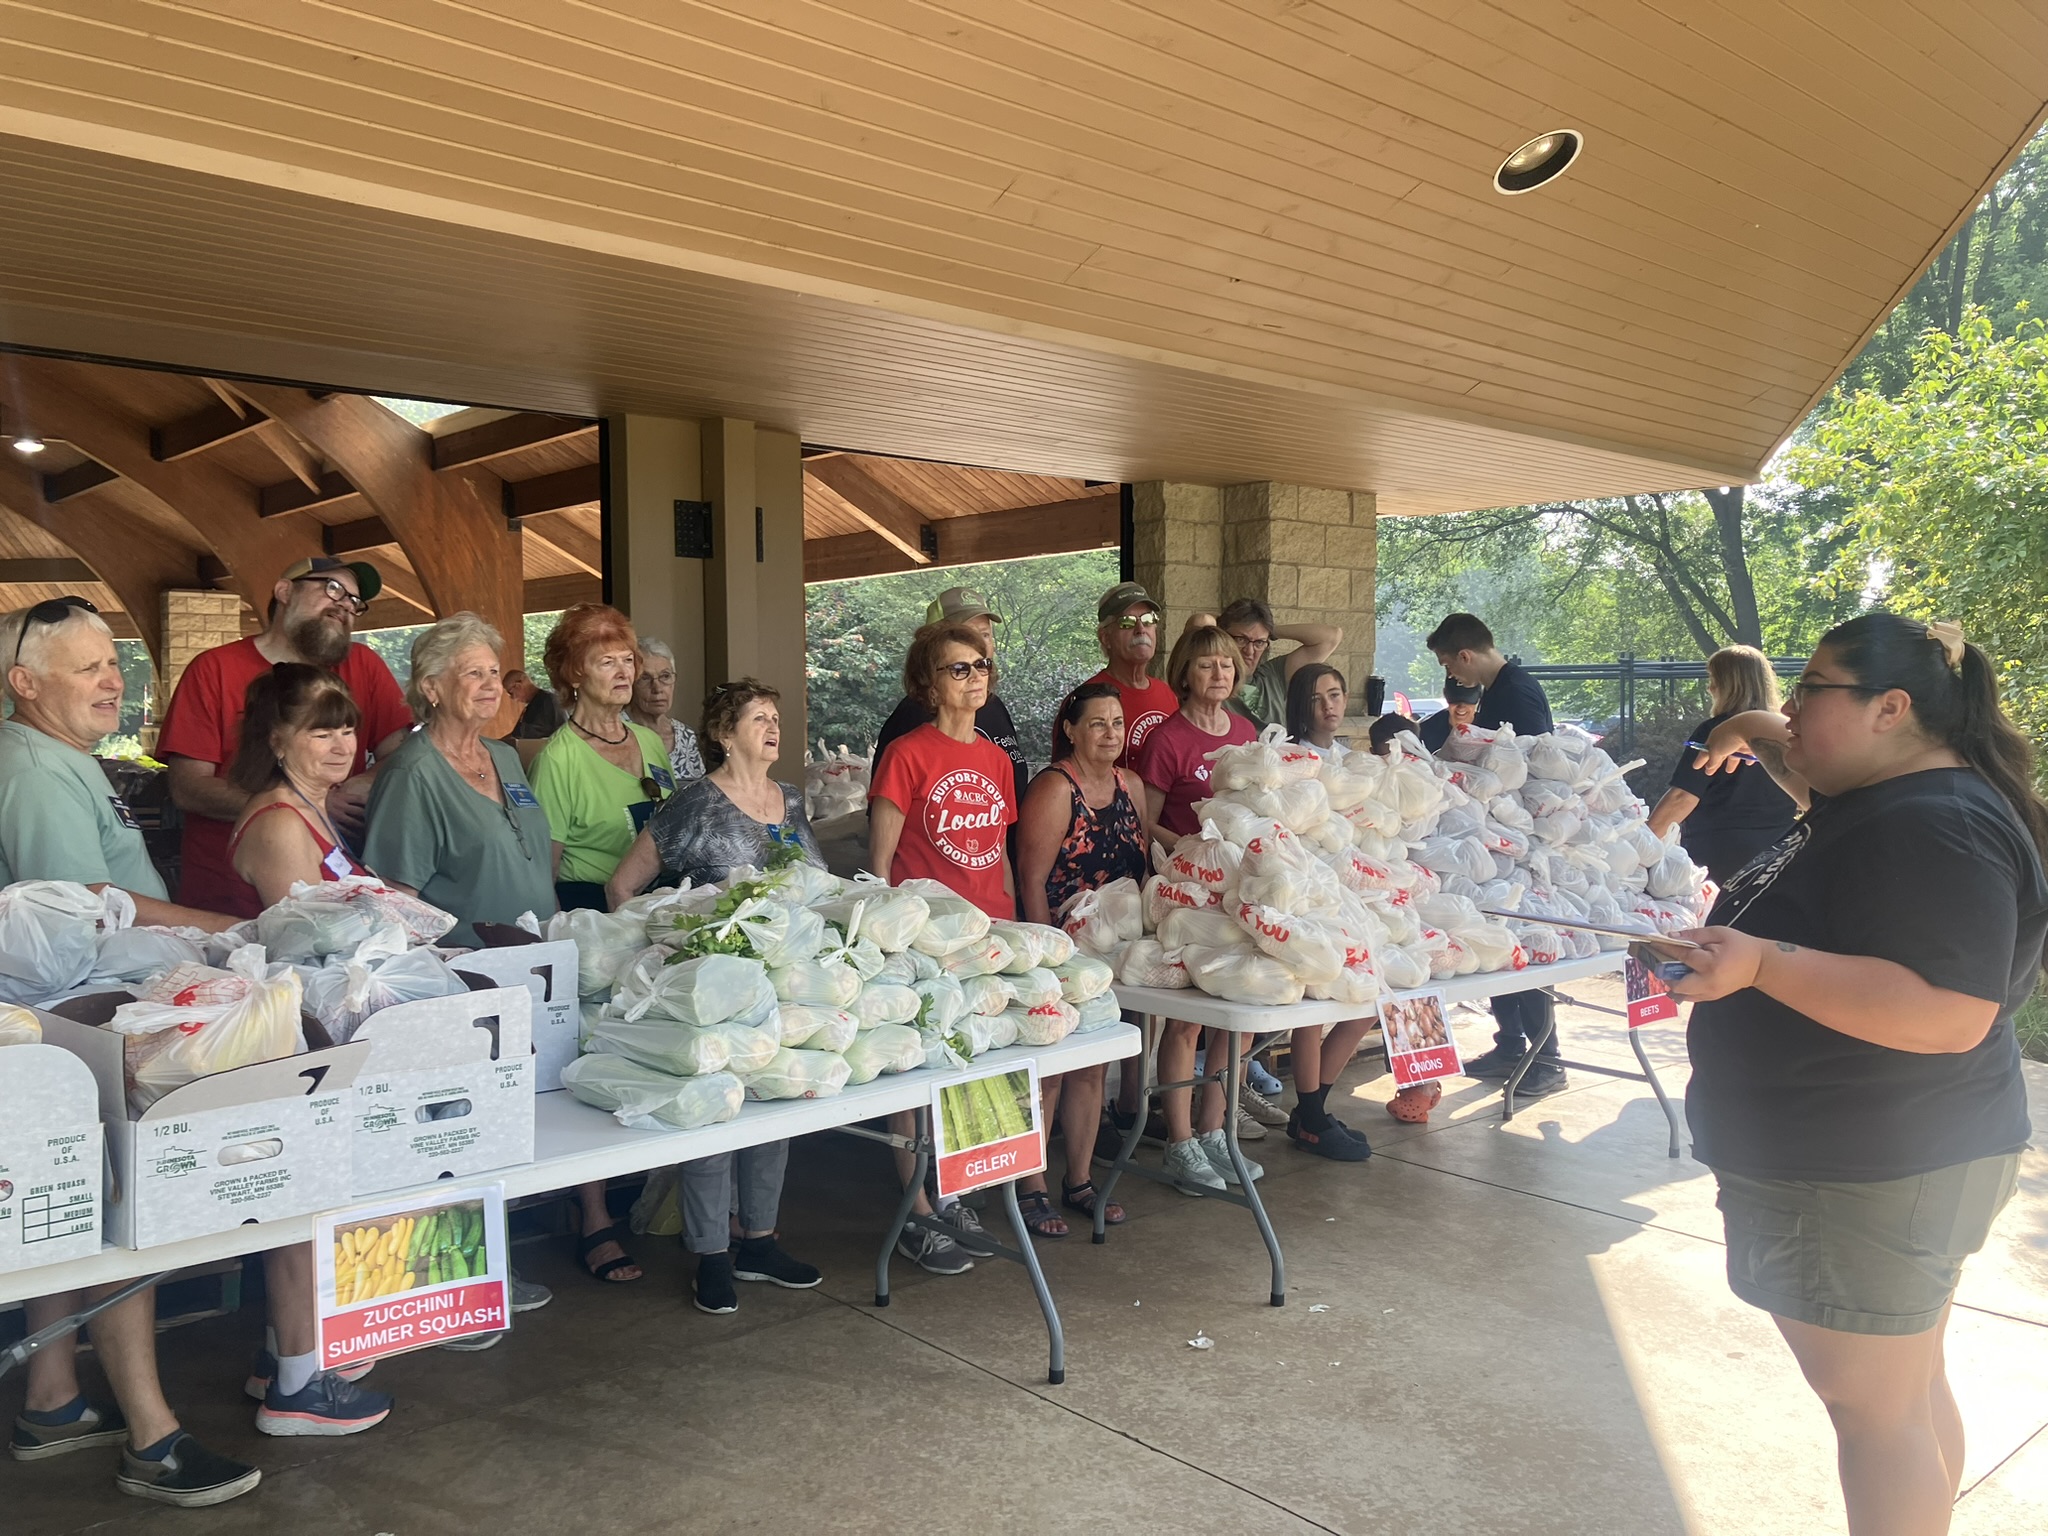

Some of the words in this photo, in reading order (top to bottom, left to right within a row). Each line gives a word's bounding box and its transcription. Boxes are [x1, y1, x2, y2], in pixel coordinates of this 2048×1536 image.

[1131, 715, 1163, 746] SUPPORT
[931, 773, 978, 804] SUPPORT
[981, 778, 1006, 810] YOUR
[962, 791, 988, 803] ACBC
[937, 803, 1001, 833] Local
[935, 837, 969, 865] FOOD
[1197, 866, 1225, 883] YOU
[1255, 914, 1290, 943] YOU
[1640, 1004, 1660, 1018] BEETS
[495, 1063, 523, 1074] PRODUCE
[1409, 1058, 1443, 1075] ONIONS
[359, 1085, 373, 1096] 1/2
[375, 1083, 392, 1094] BU.
[499, 1080, 519, 1089] U.S.A.
[310, 1097, 340, 1109] PRODUCE
[320, 1108, 329, 1116] OF
[315, 1116, 335, 1126] U.S.A.
[154, 1126, 170, 1137] 1/2
[173, 1122, 192, 1135] BU.
[413, 1133, 437, 1143] GROWN
[443, 1128, 468, 1138] PACKED
[47, 1133, 87, 1147] PRODUCE
[425, 1137, 448, 1146] VALLEY
[449, 1133, 470, 1142] FARMS
[61, 1146, 72, 1155] OF
[54, 1154, 80, 1166] U.S.A.
[156, 1155, 195, 1165] MINNESOTA
[965, 1150, 1017, 1178] CELERY
[209, 1187, 226, 1196] VINE
[227, 1182, 254, 1192] VALLEY
[255, 1177, 279, 1187] FARMS
[279, 1174, 292, 1182] INC
[213, 1177, 241, 1188] GROWN
[249, 1170, 277, 1182] PACKED
[30, 1184, 54, 1196] GREEN
[57, 1178, 86, 1191] SQUASH
[69, 1192, 93, 1203] SMALL
[64, 1207, 93, 1219] MEDIUM
[71, 1221, 93, 1232] LARGE
[363, 1293, 454, 1328] ZUCCHINI
[459, 1290, 465, 1306] /
[328, 1324, 414, 1358] SUMMER
[419, 1306, 501, 1334] SQUASH
